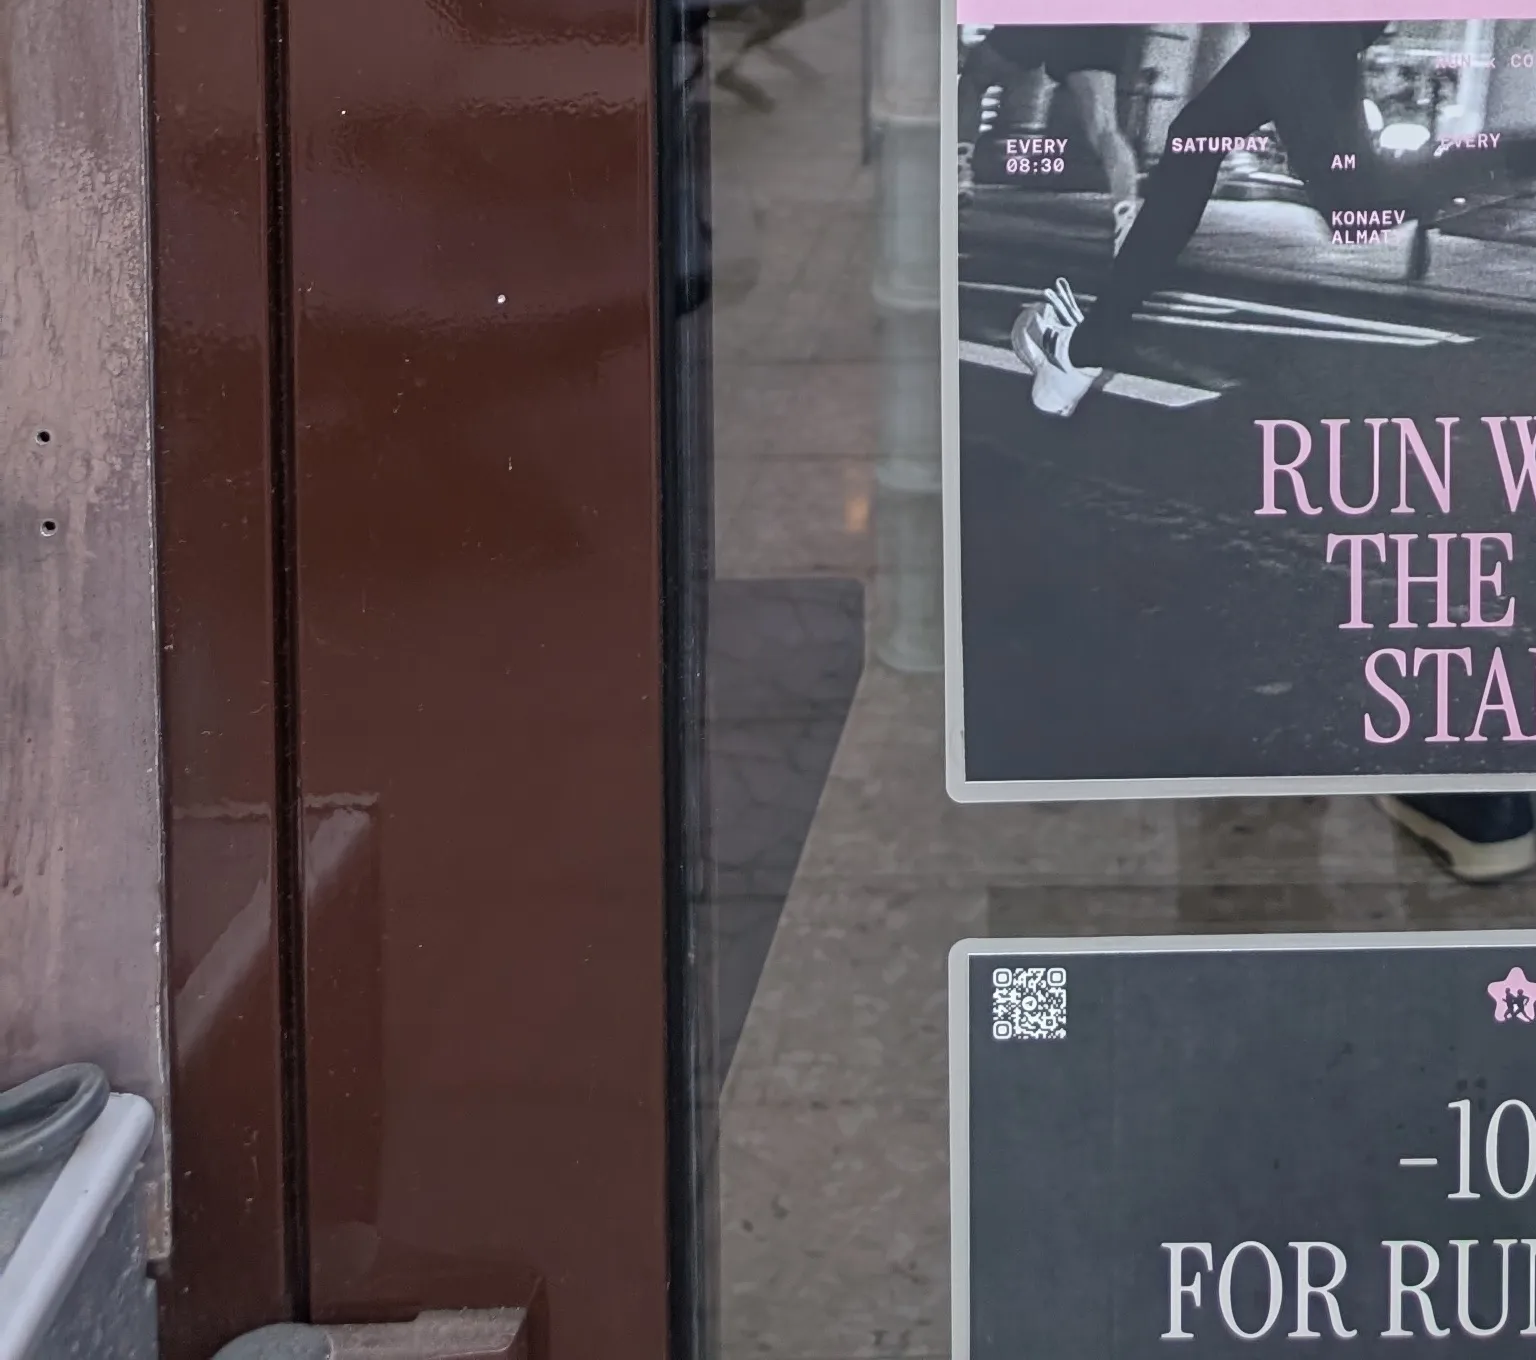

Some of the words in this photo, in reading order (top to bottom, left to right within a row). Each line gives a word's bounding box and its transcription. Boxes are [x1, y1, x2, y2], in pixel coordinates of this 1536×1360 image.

[1007, 139, 1068, 154] EVERY
[1171, 136, 1269, 153] SATURDAY
[1440, 133, 1501, 148] EVERY
[1007, 158, 1065, 173] 08:30
[1331, 154, 1356, 169] AM
[1332, 210, 1405, 226] KONAEV
[1254, 416, 1461, 515] RUN
[1326, 532, 1516, 629] THE
[1160, 1238, 1358, 1340] FOR
